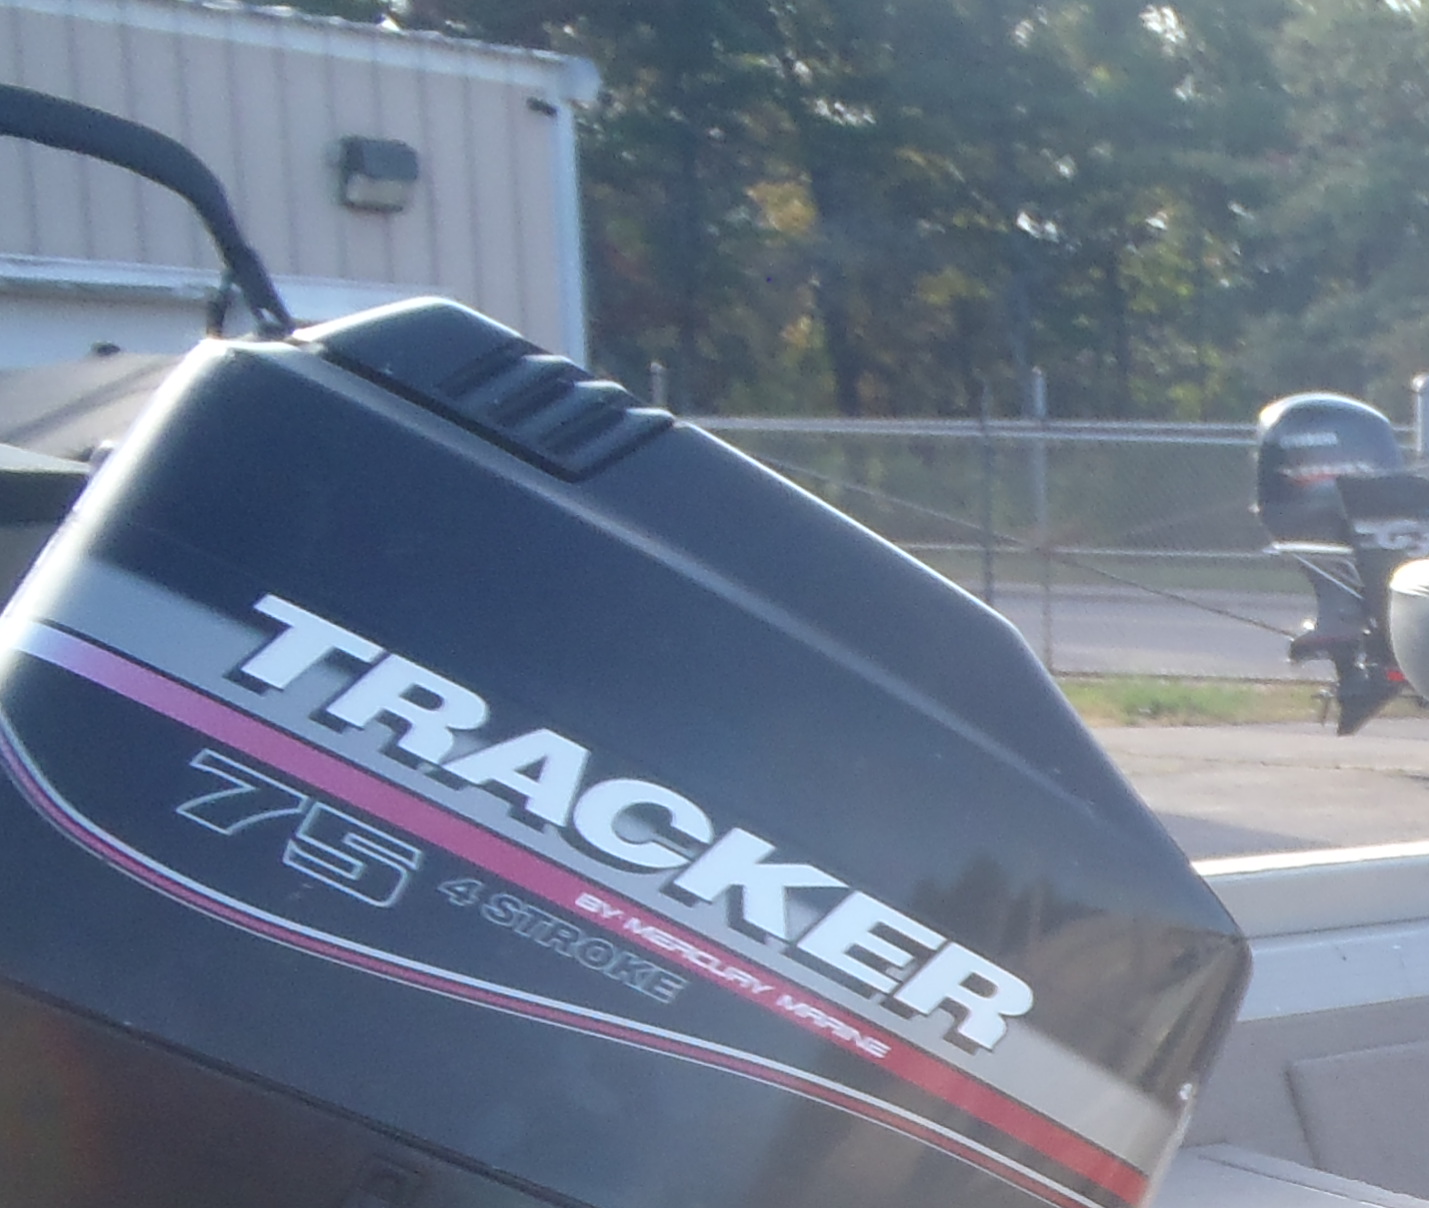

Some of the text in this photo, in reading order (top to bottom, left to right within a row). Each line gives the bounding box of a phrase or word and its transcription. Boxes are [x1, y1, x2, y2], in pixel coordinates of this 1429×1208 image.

[175, 747, 423, 907] 75
[240, 594, 1034, 1051] TRACKER
[436, 877, 689, 1004] 4 STROKE
[574, 891, 892, 1059] BY MERCURY MARINE
